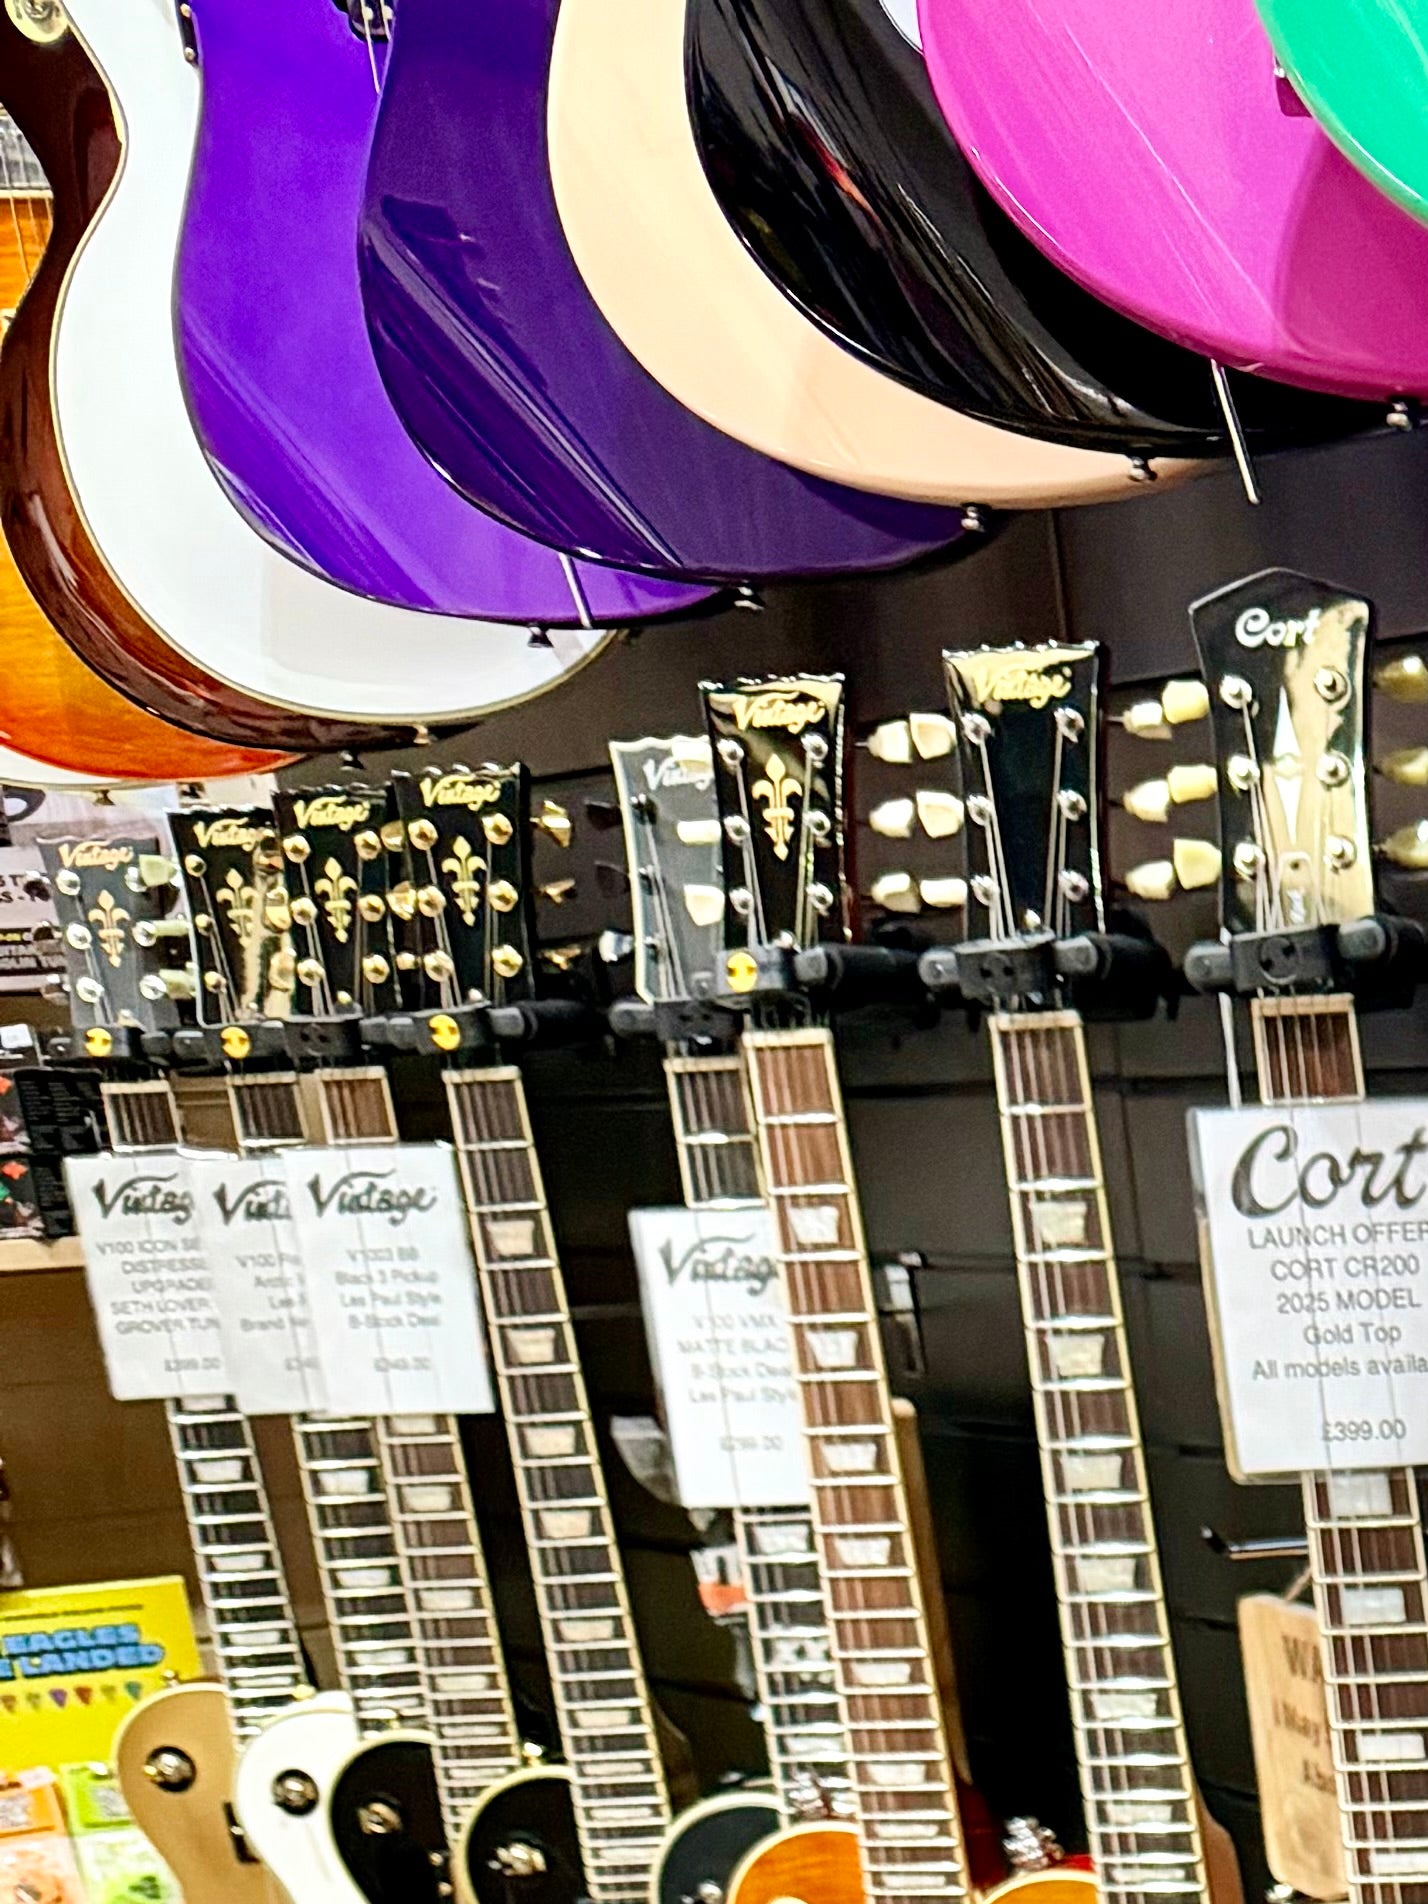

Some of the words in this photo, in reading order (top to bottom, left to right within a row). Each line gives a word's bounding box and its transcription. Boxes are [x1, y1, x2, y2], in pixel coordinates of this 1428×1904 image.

[1235, 608, 1321, 647] Cort
[972, 667, 1073, 709] Vintage
[732, 691, 826, 733] Vintage
[419, 774, 500, 811] Vintage
[293, 796, 371, 831] Vintage
[59, 841, 134, 870] Vintage
[307, 1169, 438, 1227] Vintage
[1248, 1225, 1347, 1249] LAUNCH
[1270, 1258, 1338, 1280] CORT
[1345, 1254, 1419, 1277] CR200
[1276, 1291, 1331, 1313] 2025
[1336, 1288, 1422, 1310] MODEL
[1303, 1323, 1354, 1346] Gold
[1359, 1324, 1402, 1347] Top
[1252, 1359, 1278, 1380] All
[1283, 1356, 1361, 1378] models
[1322, 1420, 1406, 1442] £399.00
[2, 1623, 139, 1655] EAGLES
[20, 1644, 164, 1678] LANDED
